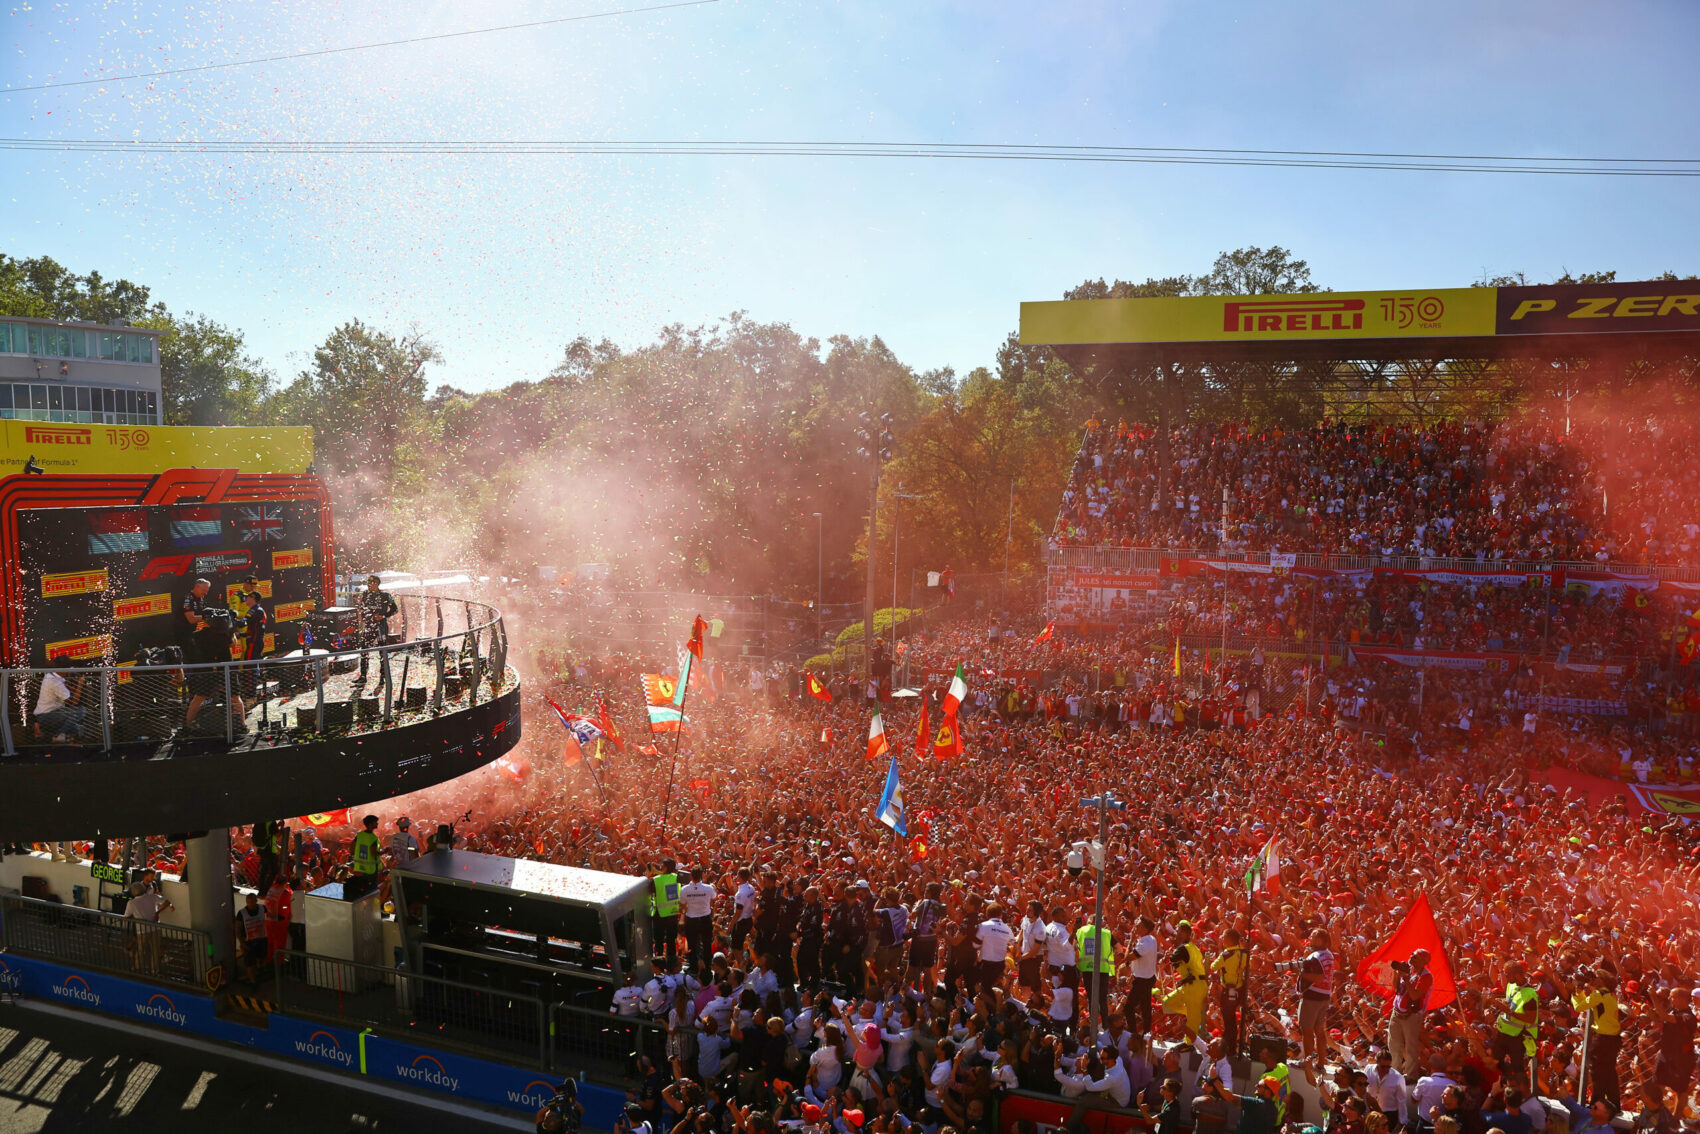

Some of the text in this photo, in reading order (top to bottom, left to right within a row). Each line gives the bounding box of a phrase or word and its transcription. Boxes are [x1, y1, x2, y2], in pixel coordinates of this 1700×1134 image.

[1223, 296, 1445, 332] PIRELLI 150
[1510, 294, 1700, 320] P ZER
[25, 426, 150, 451] PIRELLI 150
[45, 577, 85, 592] PIRELLI
[117, 601, 151, 616] PIRELLI
[93, 863, 124, 883] GEORGE
[52, 984, 101, 1006] workday
[136, 1003, 186, 1026] workday
[295, 1040, 352, 1066] workday
[397, 1065, 459, 1091] workday
[507, 1090, 547, 1109] work
